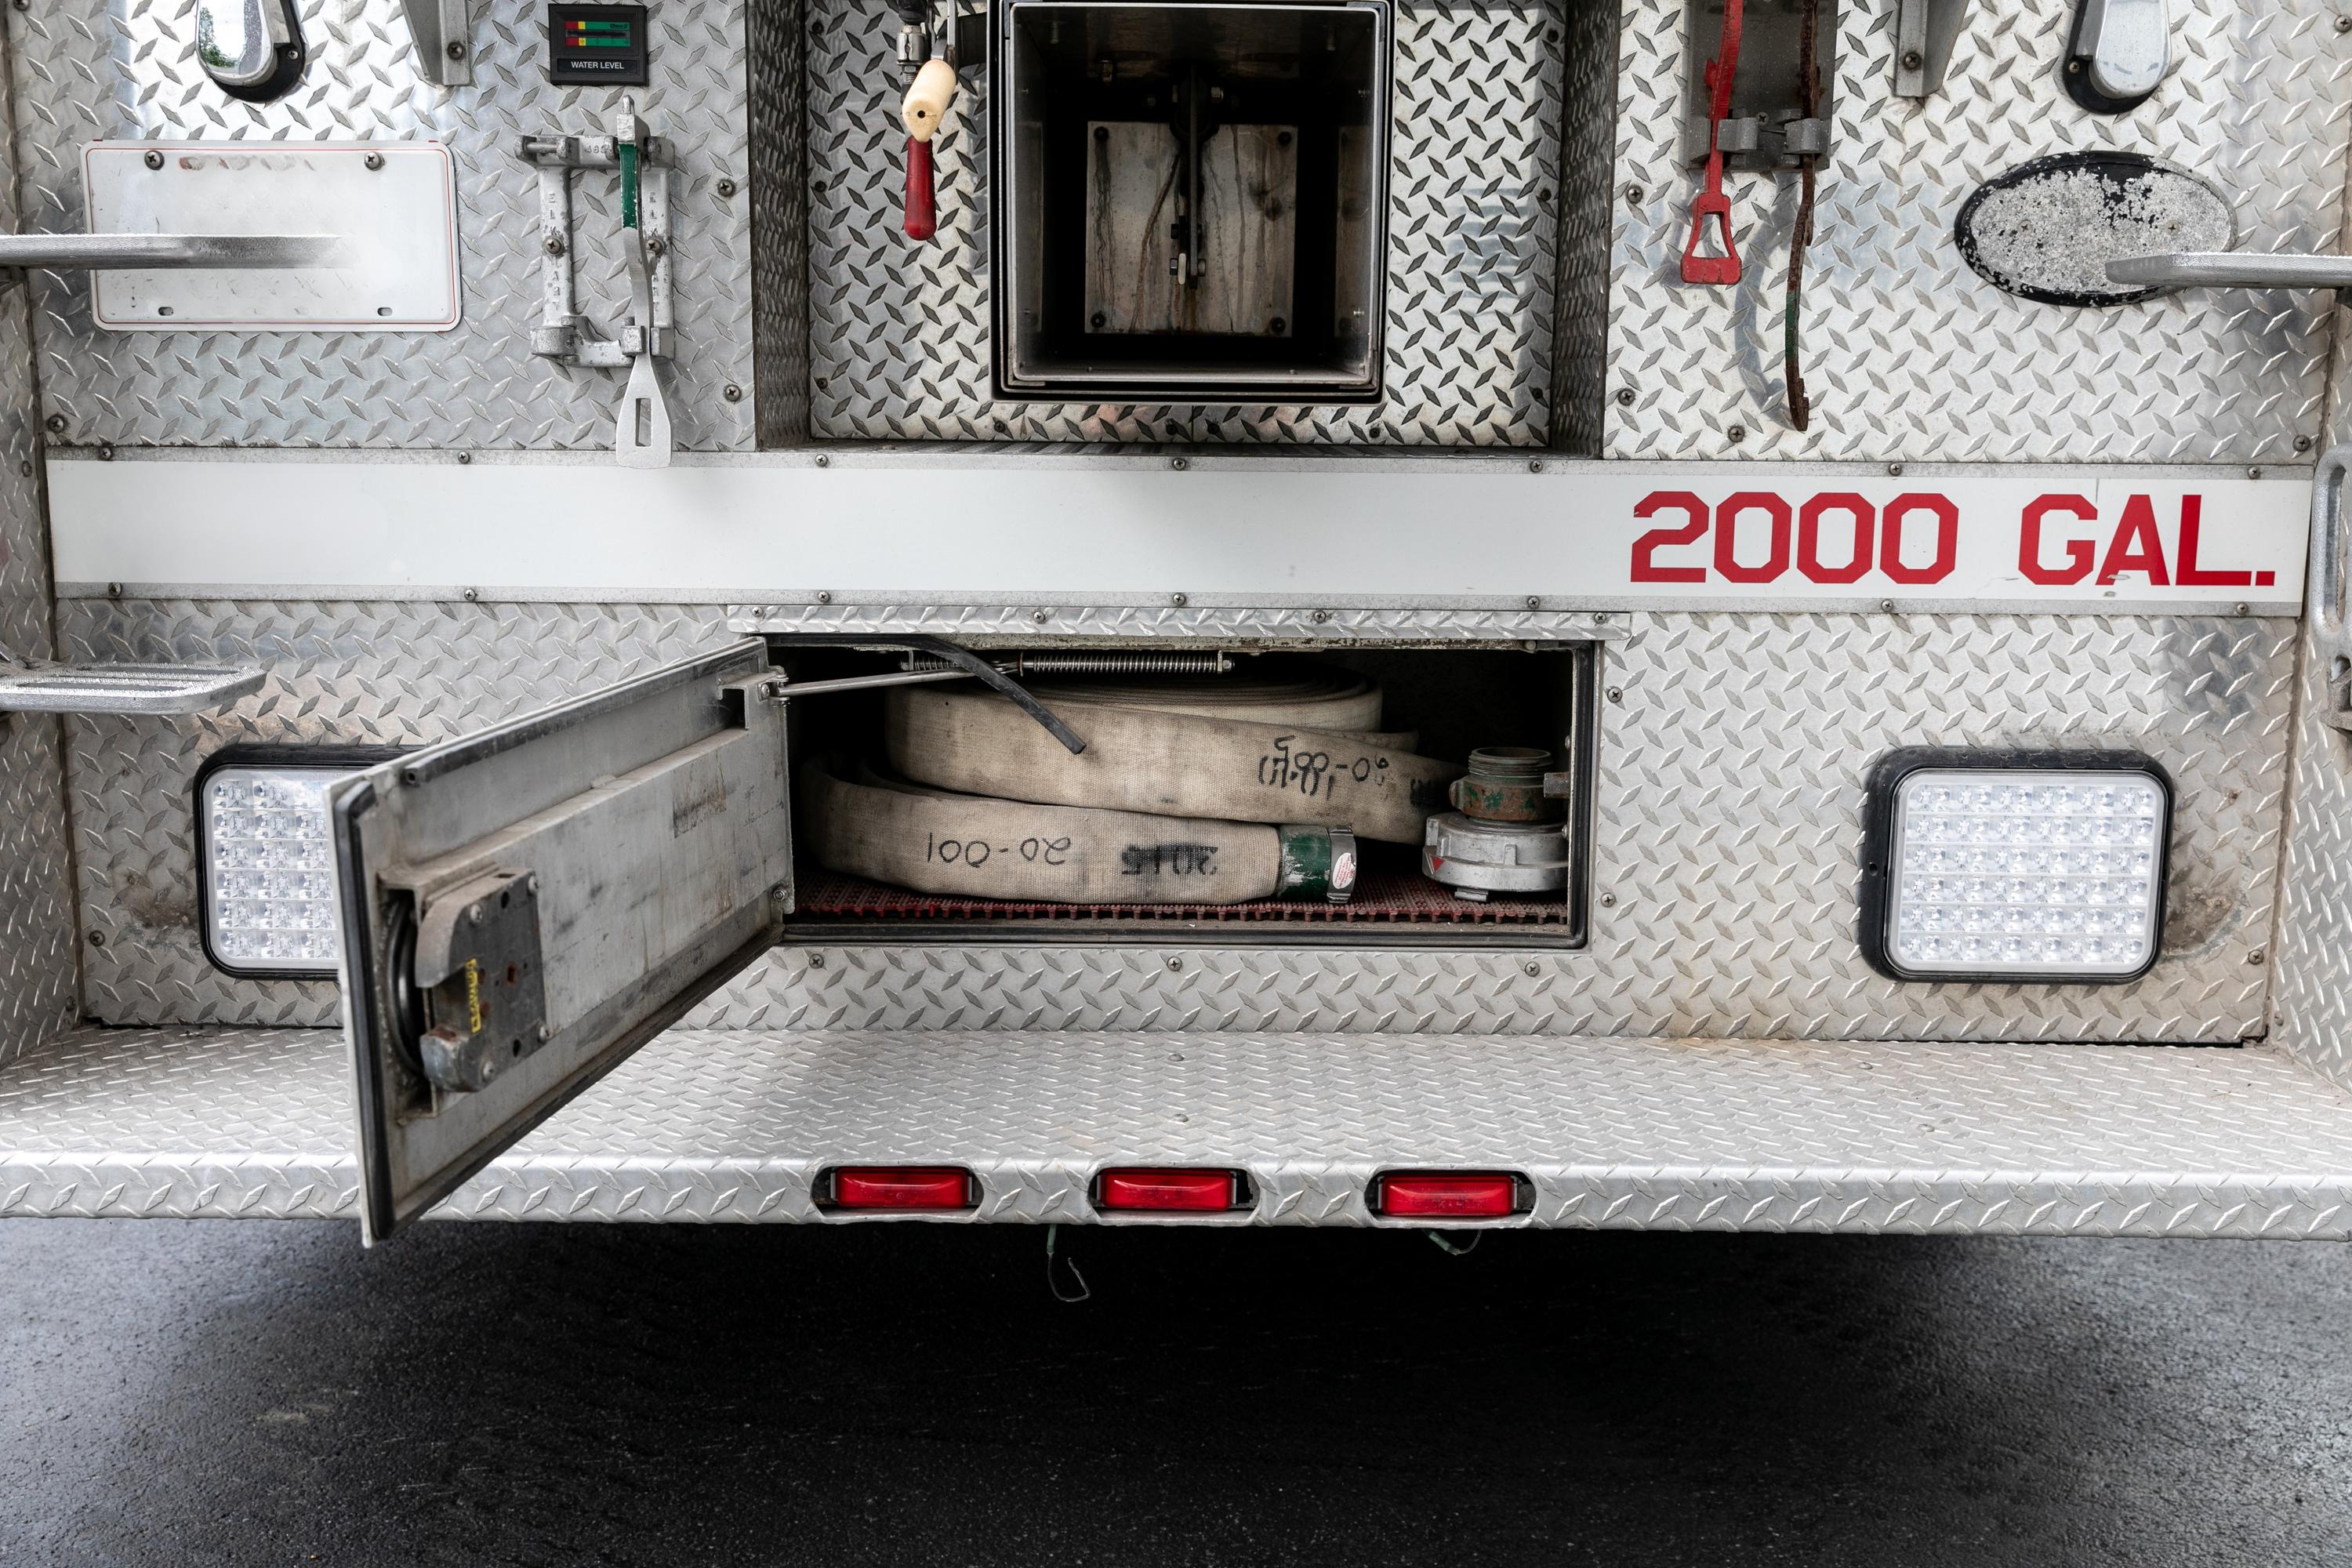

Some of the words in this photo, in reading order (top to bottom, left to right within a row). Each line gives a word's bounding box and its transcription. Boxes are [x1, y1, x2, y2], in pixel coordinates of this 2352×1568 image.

[600, 61, 625, 70] LEVEL
[1630, 491, 1959, 585] 2000
[2018, 494, 2275, 586] GAL.
[927, 832, 1072, 868] 20-001
